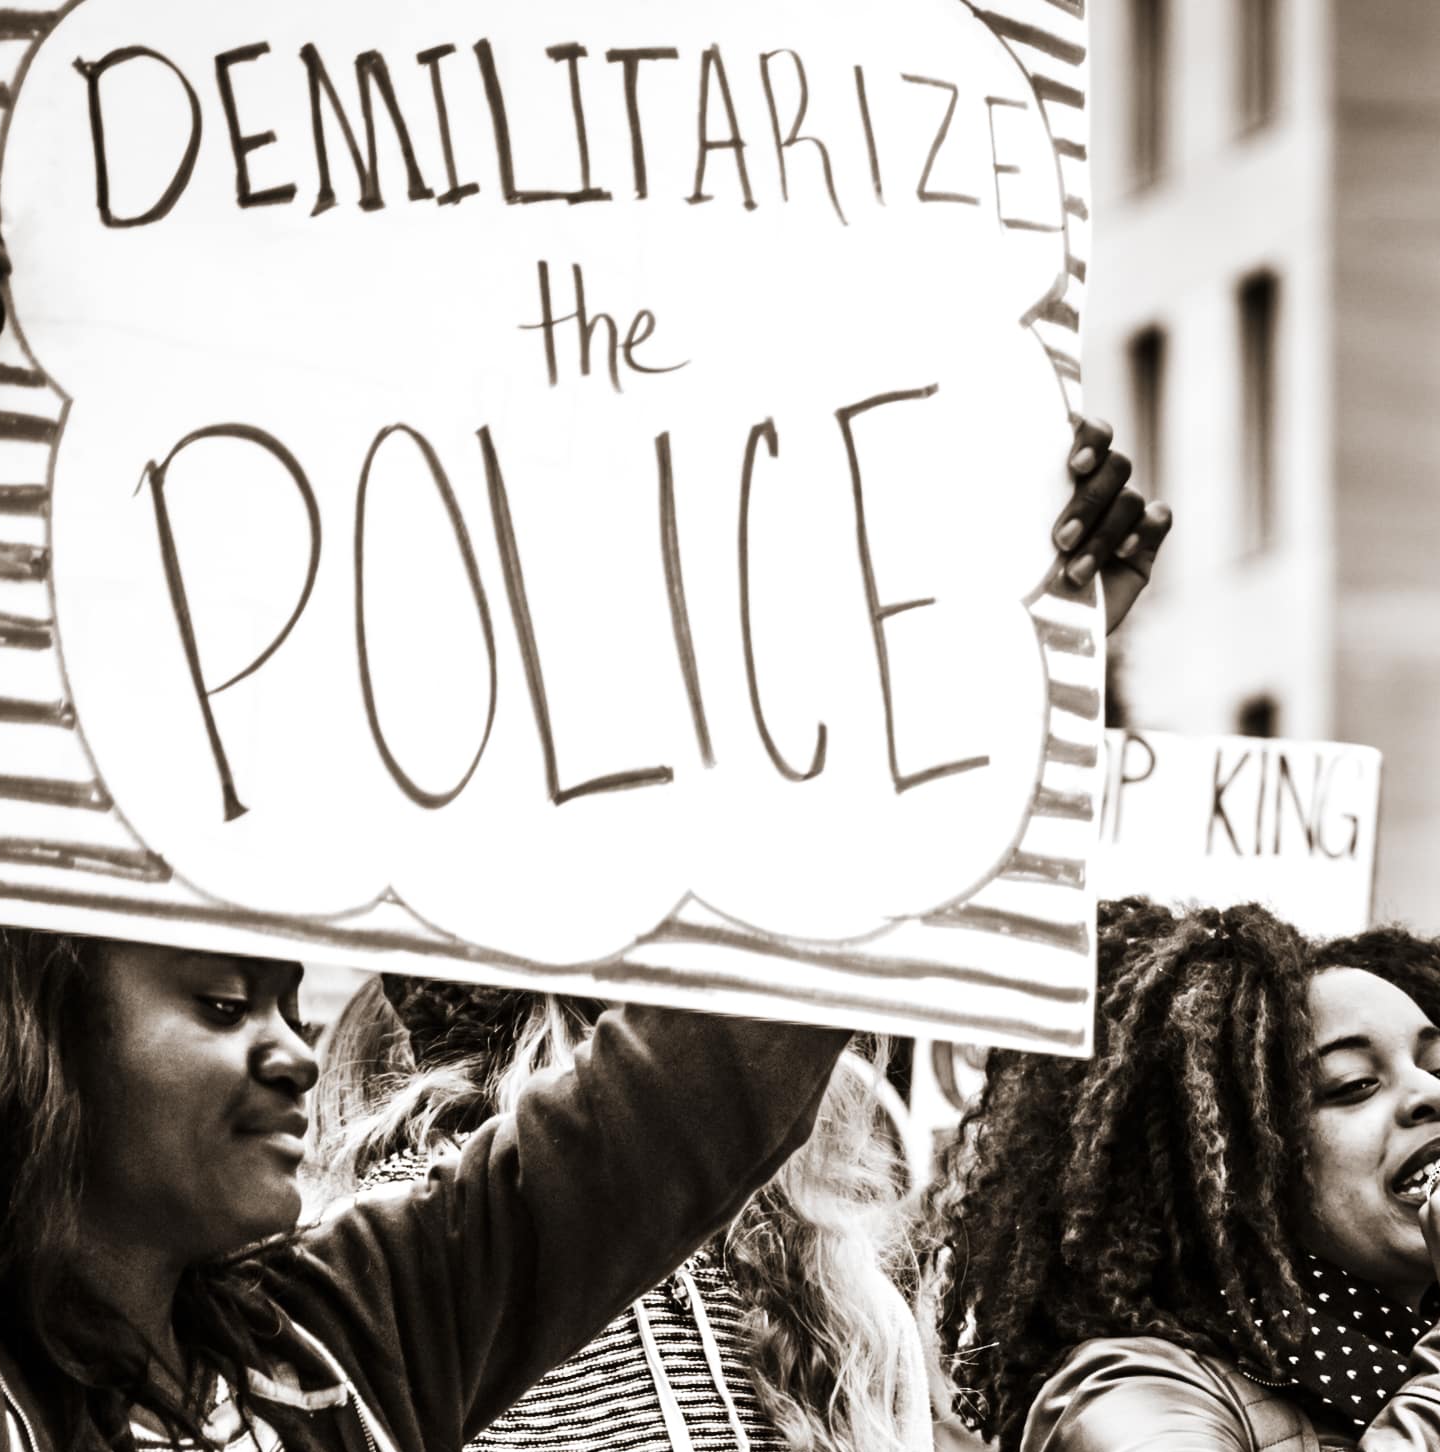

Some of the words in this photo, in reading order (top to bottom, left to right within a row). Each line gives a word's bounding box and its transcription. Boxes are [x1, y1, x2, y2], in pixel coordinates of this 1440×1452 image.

[74, 37, 1067, 230] DEMILITARIZE
[518, 259, 692, 393] the
[134, 383, 990, 822] POLICE
[1205, 747, 1359, 860] KING
